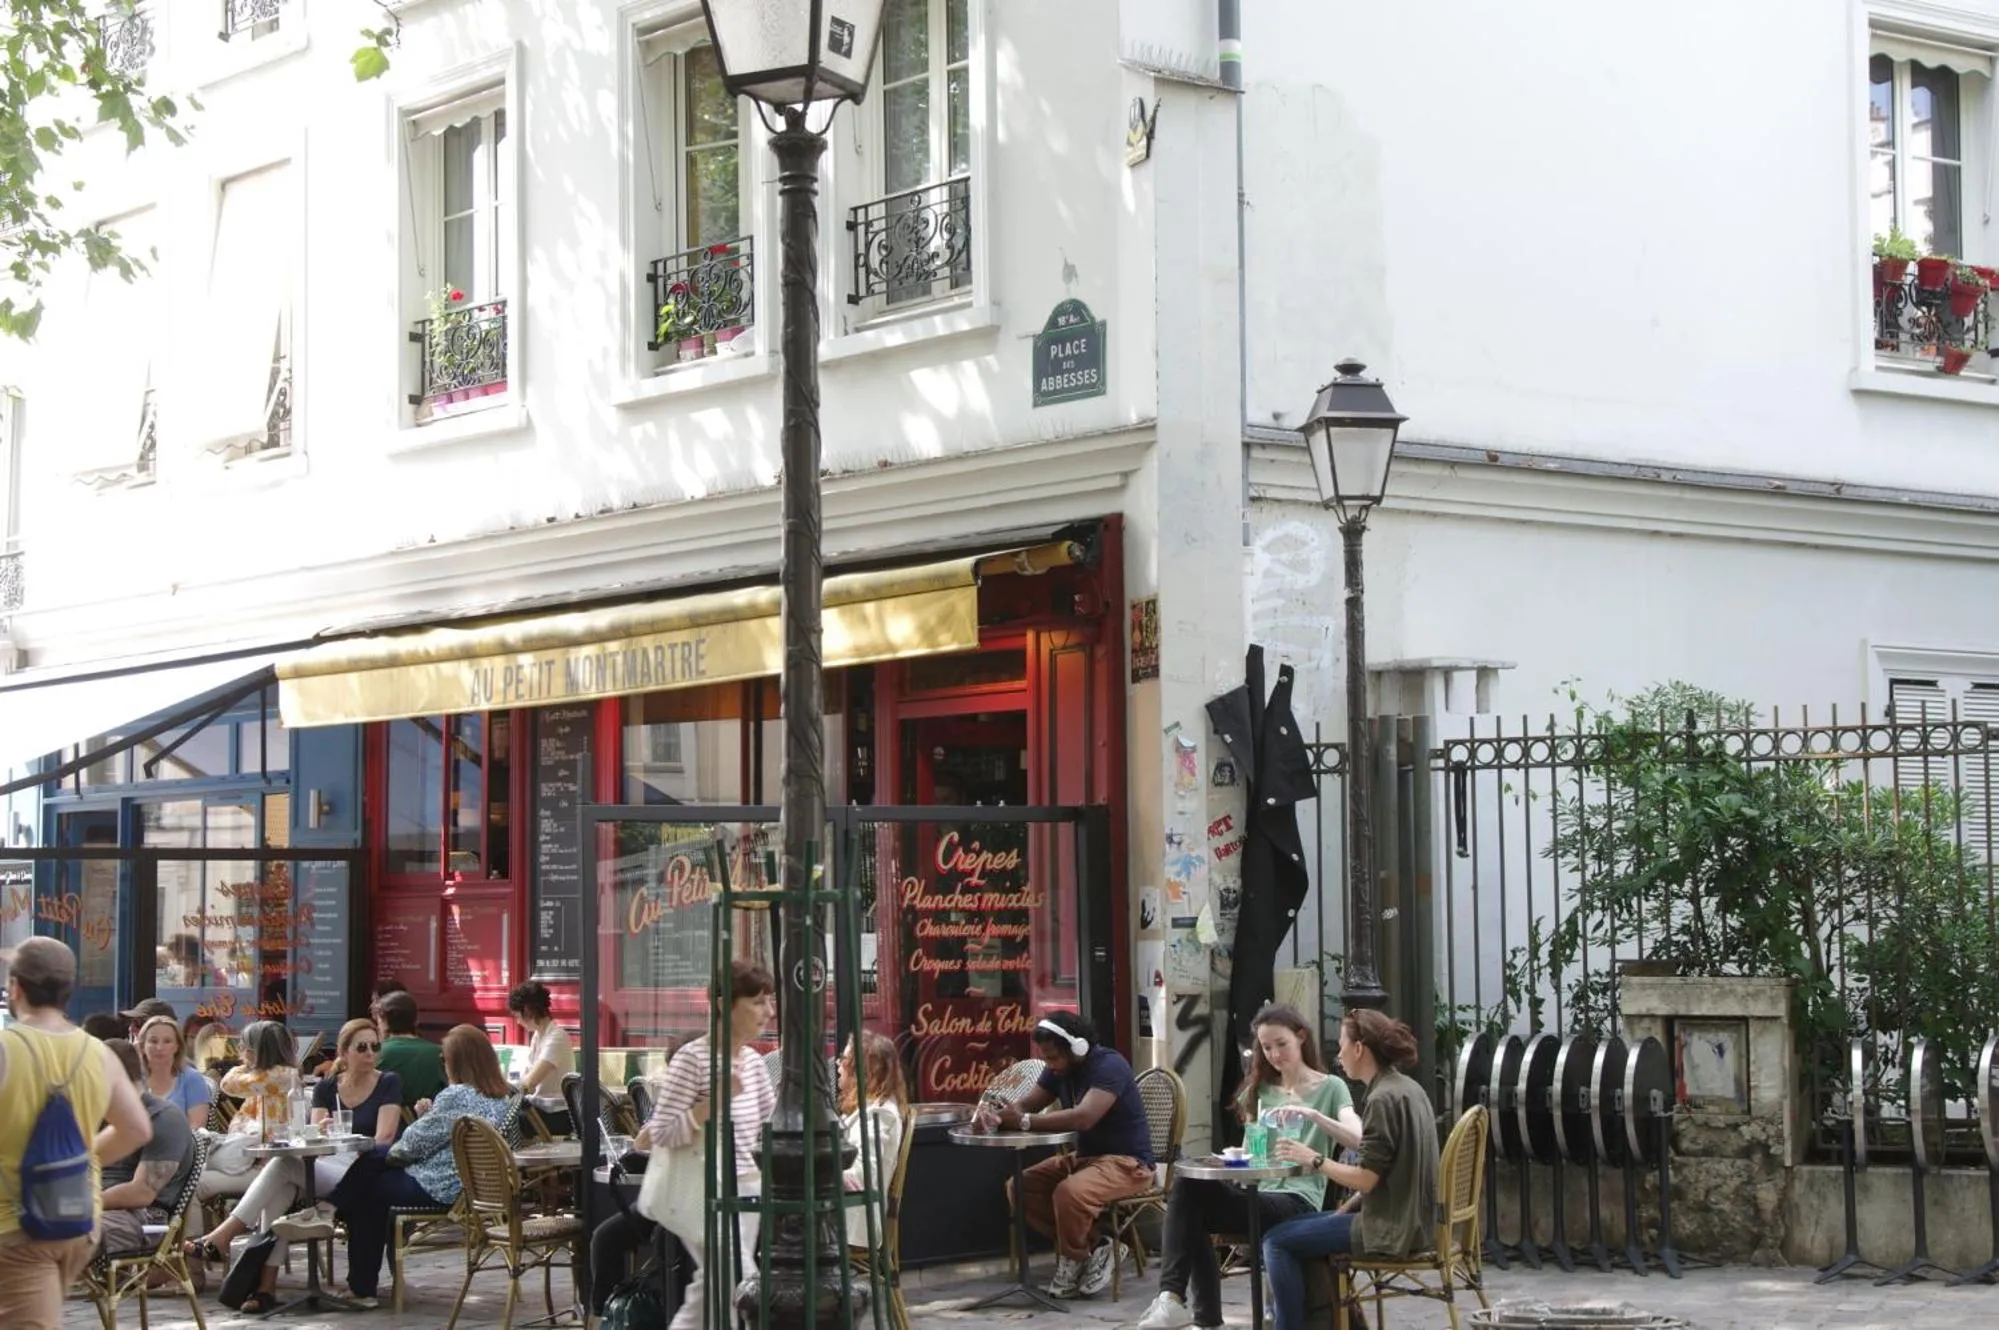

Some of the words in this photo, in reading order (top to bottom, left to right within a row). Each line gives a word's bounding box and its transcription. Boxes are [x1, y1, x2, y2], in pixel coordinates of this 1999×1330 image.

[1050, 338, 1088, 359] PLACE
[1040, 368, 1098, 392] ABBESSES
[471, 667, 495, 705] AU
[502, 659, 556, 704] PETIT
[564, 638, 707, 695] MONTMARTRE
[935, 831, 1021, 883] Crêpes
[902, 876, 979, 909] Planches
[910, 948, 963, 980] Croques
[910, 1002, 975, 1037] Salon
[974, 1010, 993, 1034] de
